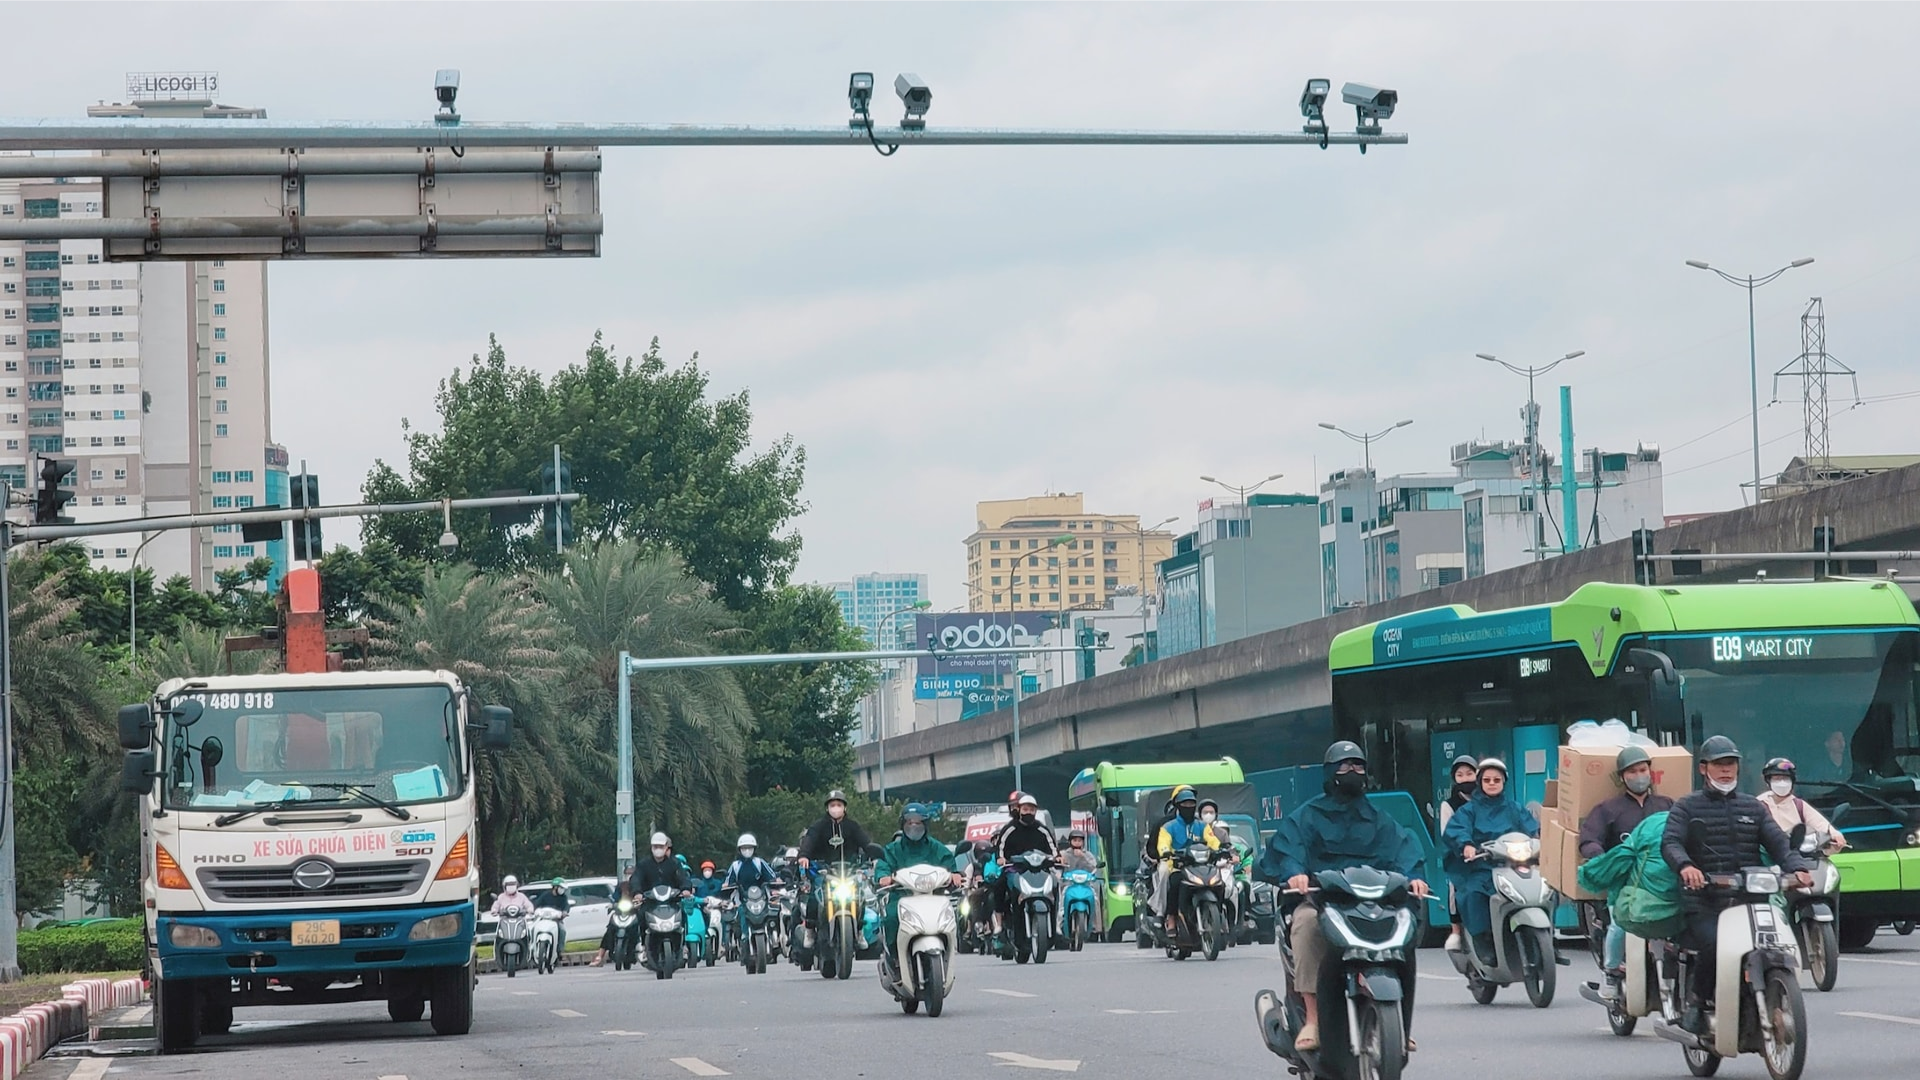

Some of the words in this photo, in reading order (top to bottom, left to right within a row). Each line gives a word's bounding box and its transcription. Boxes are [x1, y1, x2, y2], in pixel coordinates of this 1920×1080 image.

[145, 77, 197, 91] LICOGI
[201, 76, 217, 91] 13
[1383, 627, 1403, 642] OCEAN
[1387, 643, 1400, 657] CITY
[1713, 636, 1742, 661] E09
[1785, 638, 1812, 656] CITY
[210, 692, 239, 709] 480
[244, 692, 274, 709] 918
[402, 832, 436, 843] QDR
[253, 840, 270, 857] XE
[275, 833, 304, 856] SỬA
[395, 847, 433, 856] 500
[193, 854, 246, 863] HINO
[305, 922, 326, 933] 29C
[296, 932, 335, 945] 540.20
